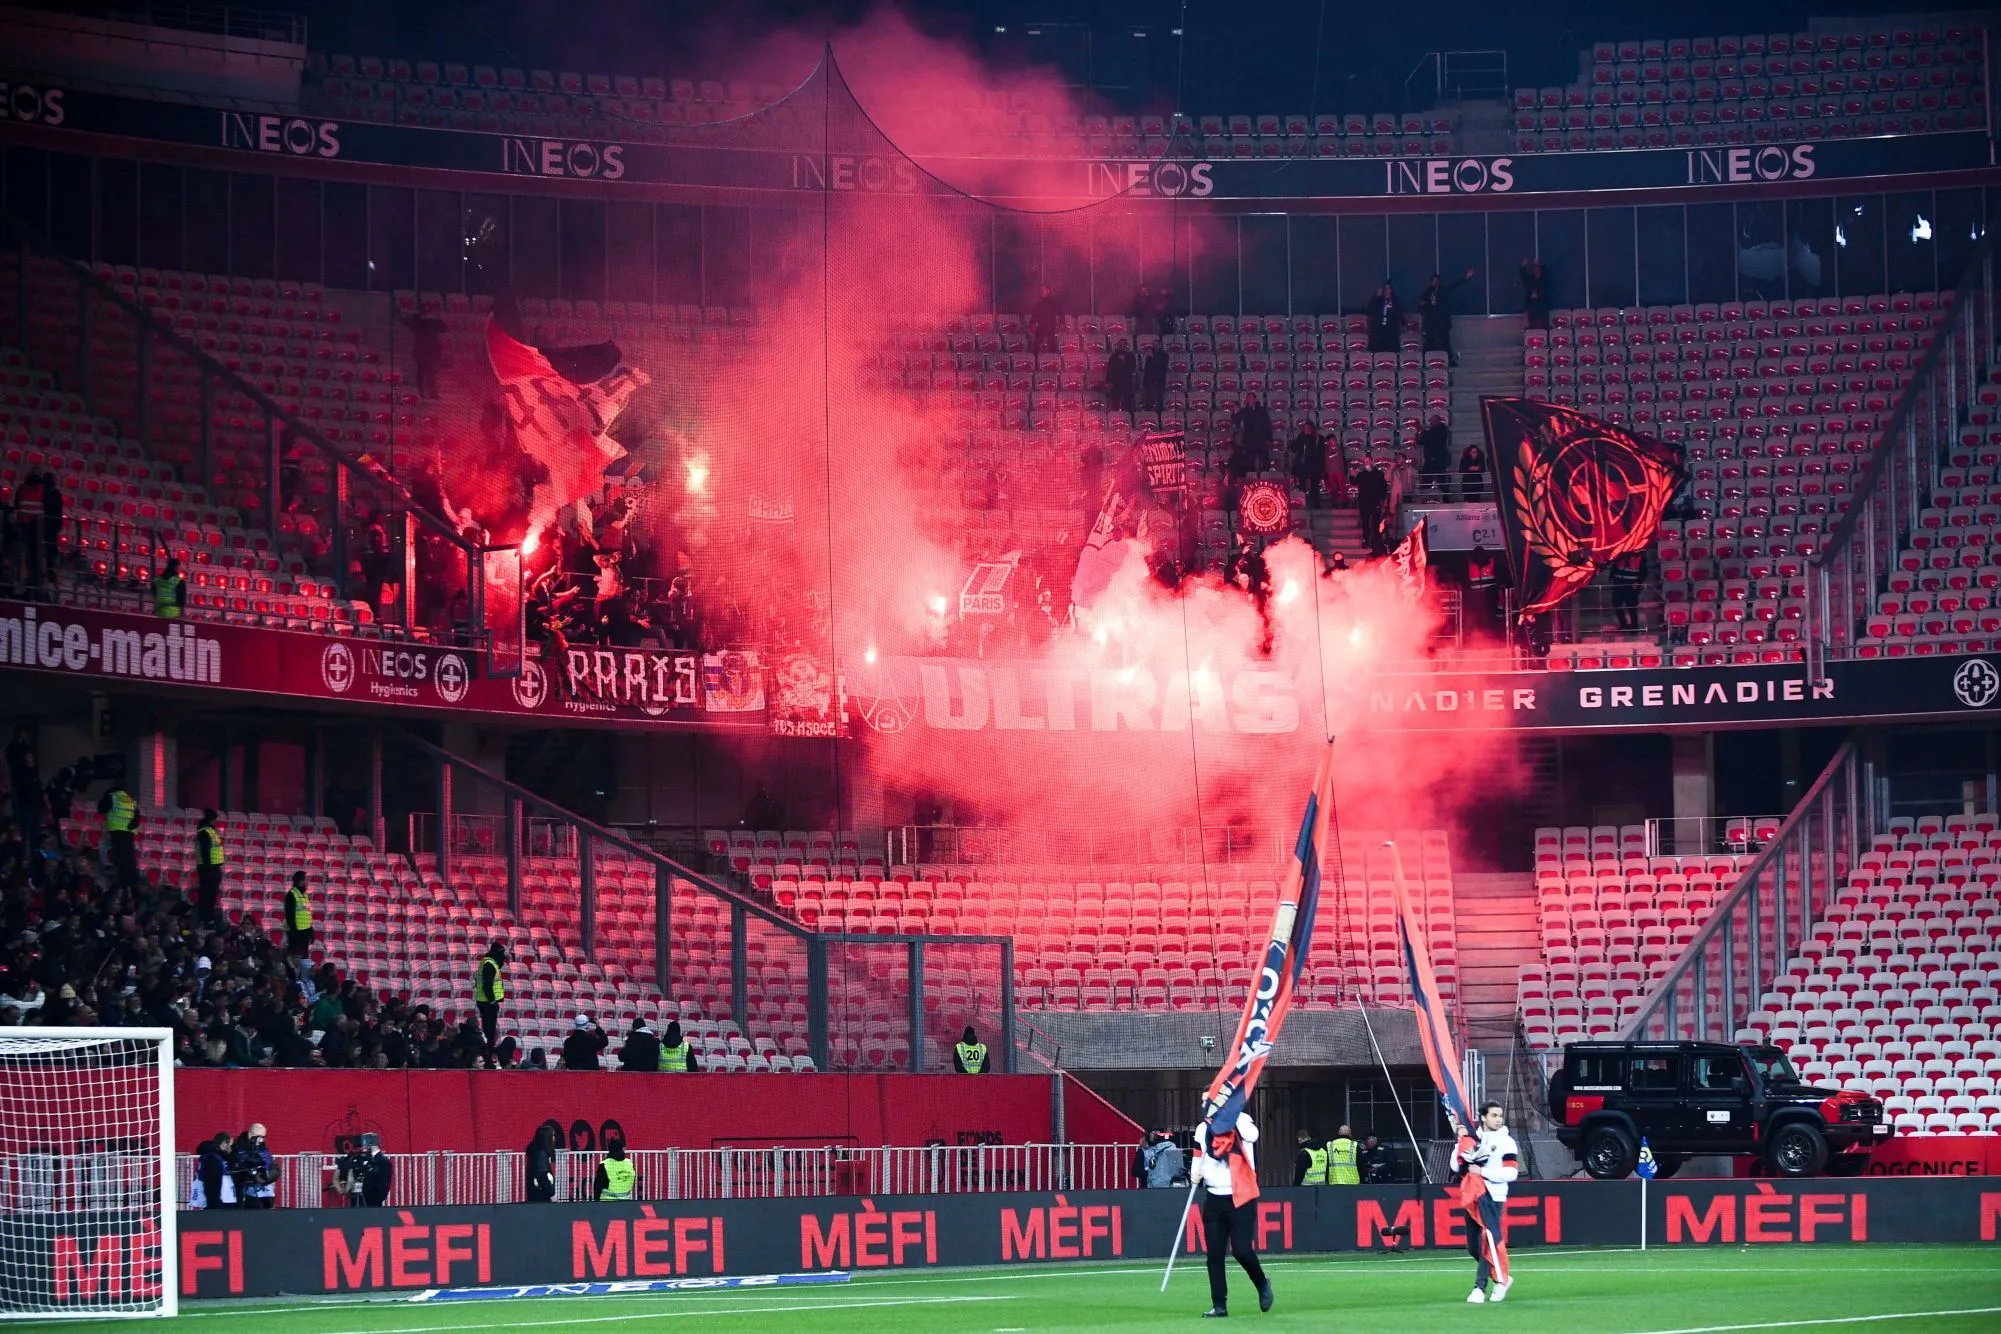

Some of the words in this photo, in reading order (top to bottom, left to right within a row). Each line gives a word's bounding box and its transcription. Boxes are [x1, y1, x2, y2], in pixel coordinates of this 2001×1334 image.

[220, 112, 340, 157] INEOS
[502, 137, 625, 180] INEOS
[791, 154, 918, 191] INEOS
[1087, 162, 1214, 197] INEOS
[1385, 158, 1514, 193] INEOS
[1687, 144, 1816, 184] INEOS
[963, 597, 1001, 610] PARIS
[0, 607, 221, 683] nice-matin
[362, 648, 427, 679] INEOS
[369, 681, 418, 698] Hygienics
[568, 650, 697, 703] PARIS
[920, 664, 1299, 734] ULTRAS
[1580, 679, 1835, 708] GRENADIER
[967, 1049, 980, 1061] 20
[801, 1199, 937, 1269] MÈFI
[1001, 1194, 1123, 1260] MÈFI
[1186, 1201, 1293, 1253] MFI
[1666, 1183, 1867, 1244] MÈFI
[54, 1215, 244, 1300] MÈFI
[323, 1212, 491, 1289] MÈFI
[572, 1205, 725, 1279] MÈFI
